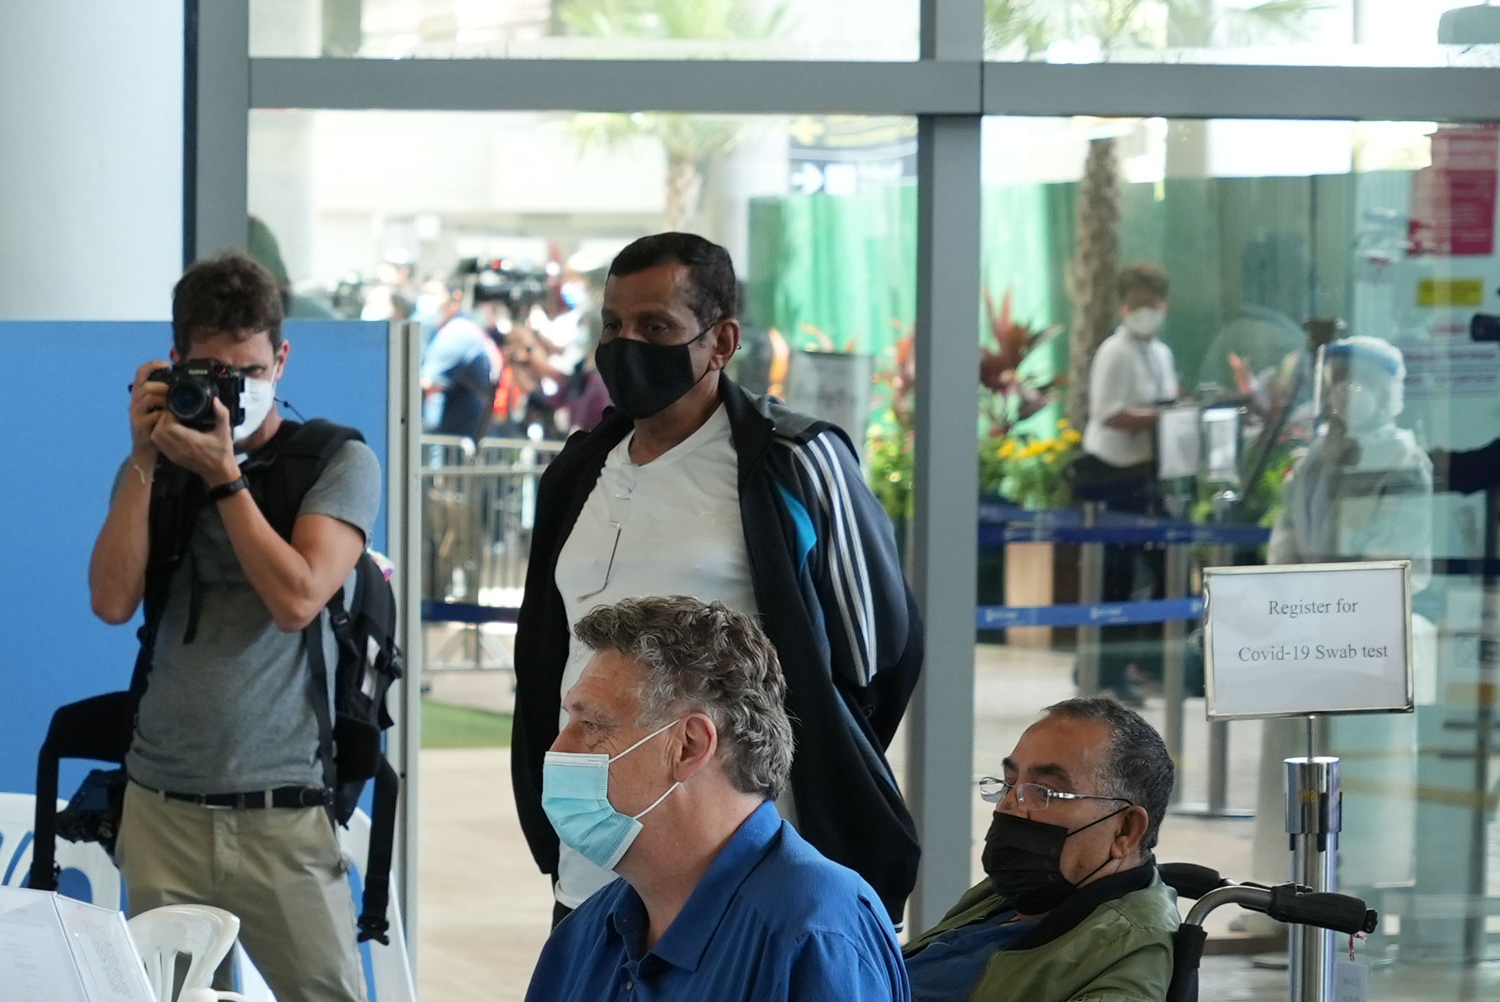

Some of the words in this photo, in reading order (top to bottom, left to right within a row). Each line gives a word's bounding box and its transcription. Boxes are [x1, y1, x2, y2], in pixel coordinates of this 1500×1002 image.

[1268, 599, 1332, 618] Register
[1336, 598, 1358, 613] for
[1238, 645, 1310, 662] Covid-19
[1315, 644, 1357, 660] Swab
[1362, 644, 1389, 658] test
